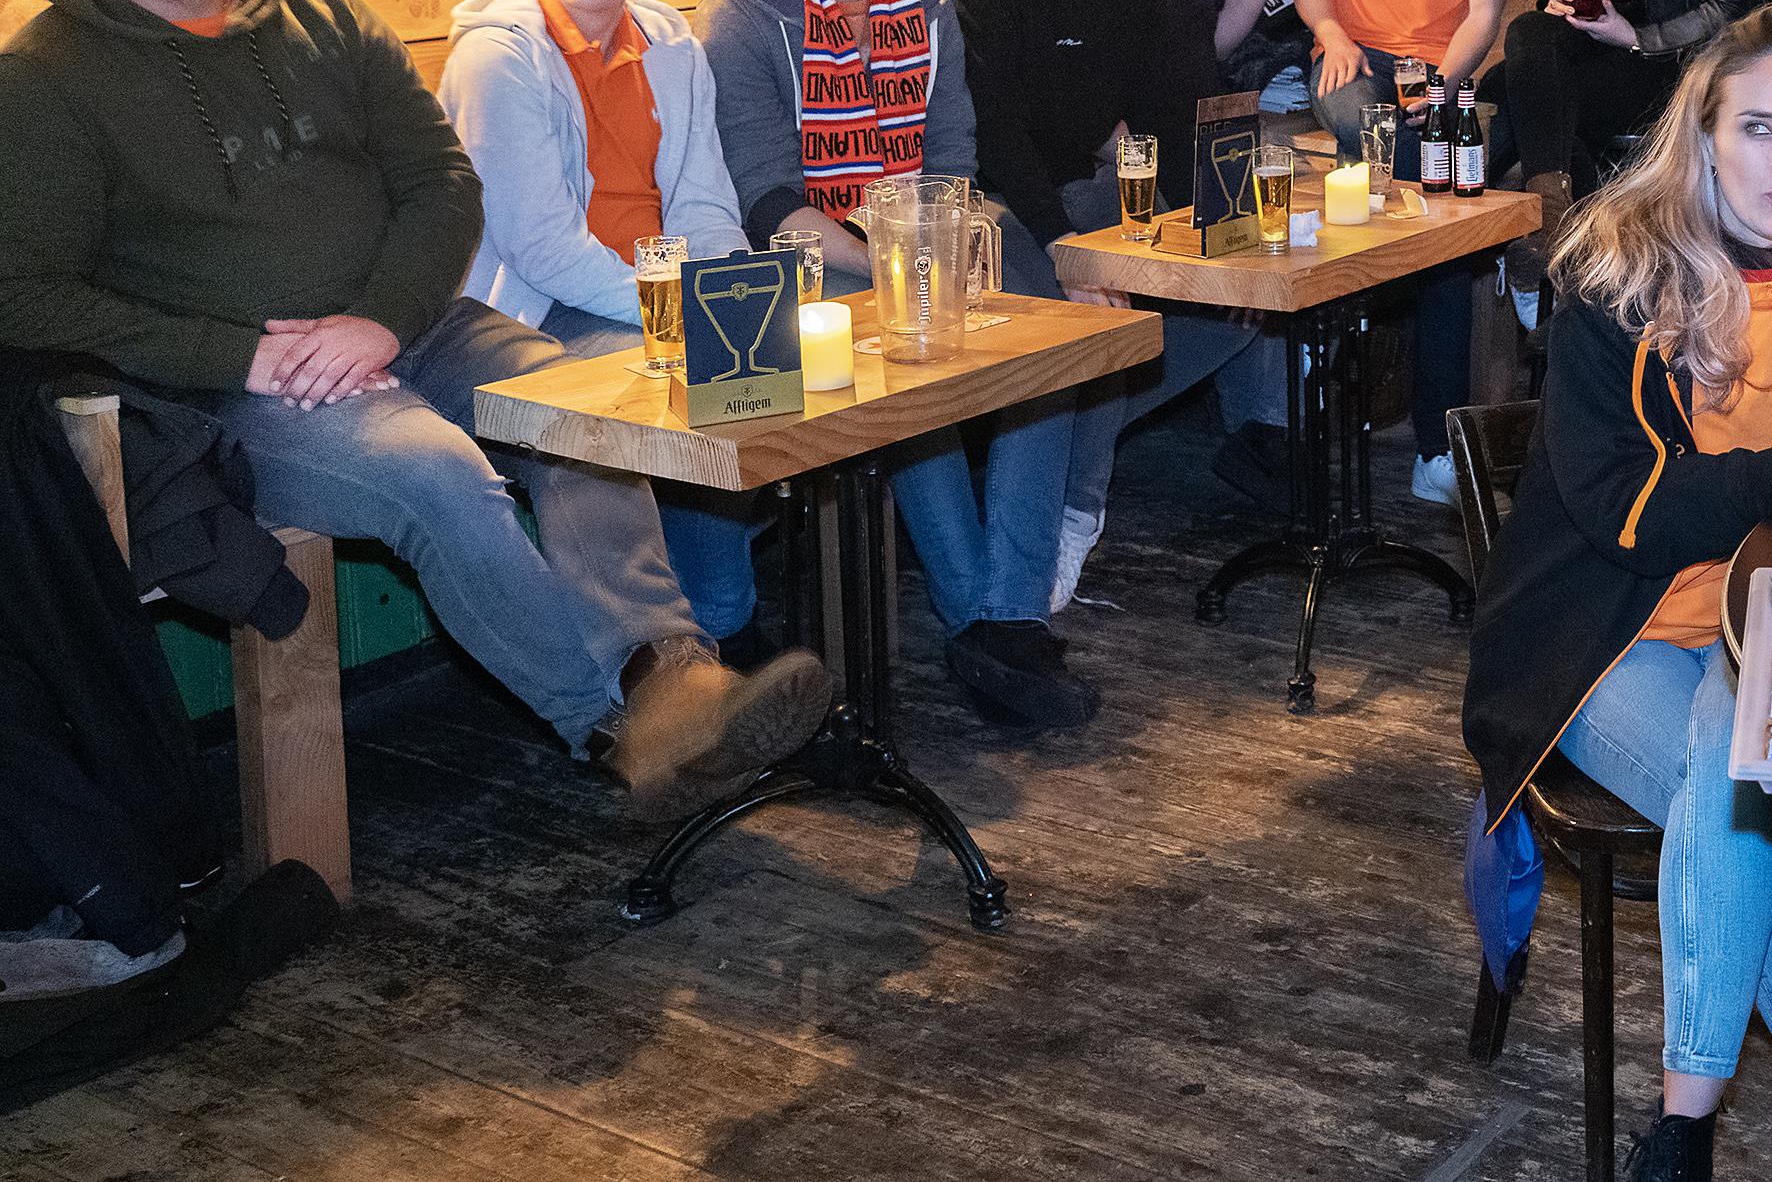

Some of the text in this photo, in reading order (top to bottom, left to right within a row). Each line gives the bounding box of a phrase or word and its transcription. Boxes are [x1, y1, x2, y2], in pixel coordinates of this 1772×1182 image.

[806, 71, 870, 103] OLLAND
[805, 128, 881, 161] OLLAND
[917, 277, 932, 324] Jupiler
[723, 397, 771, 415] Affligem
